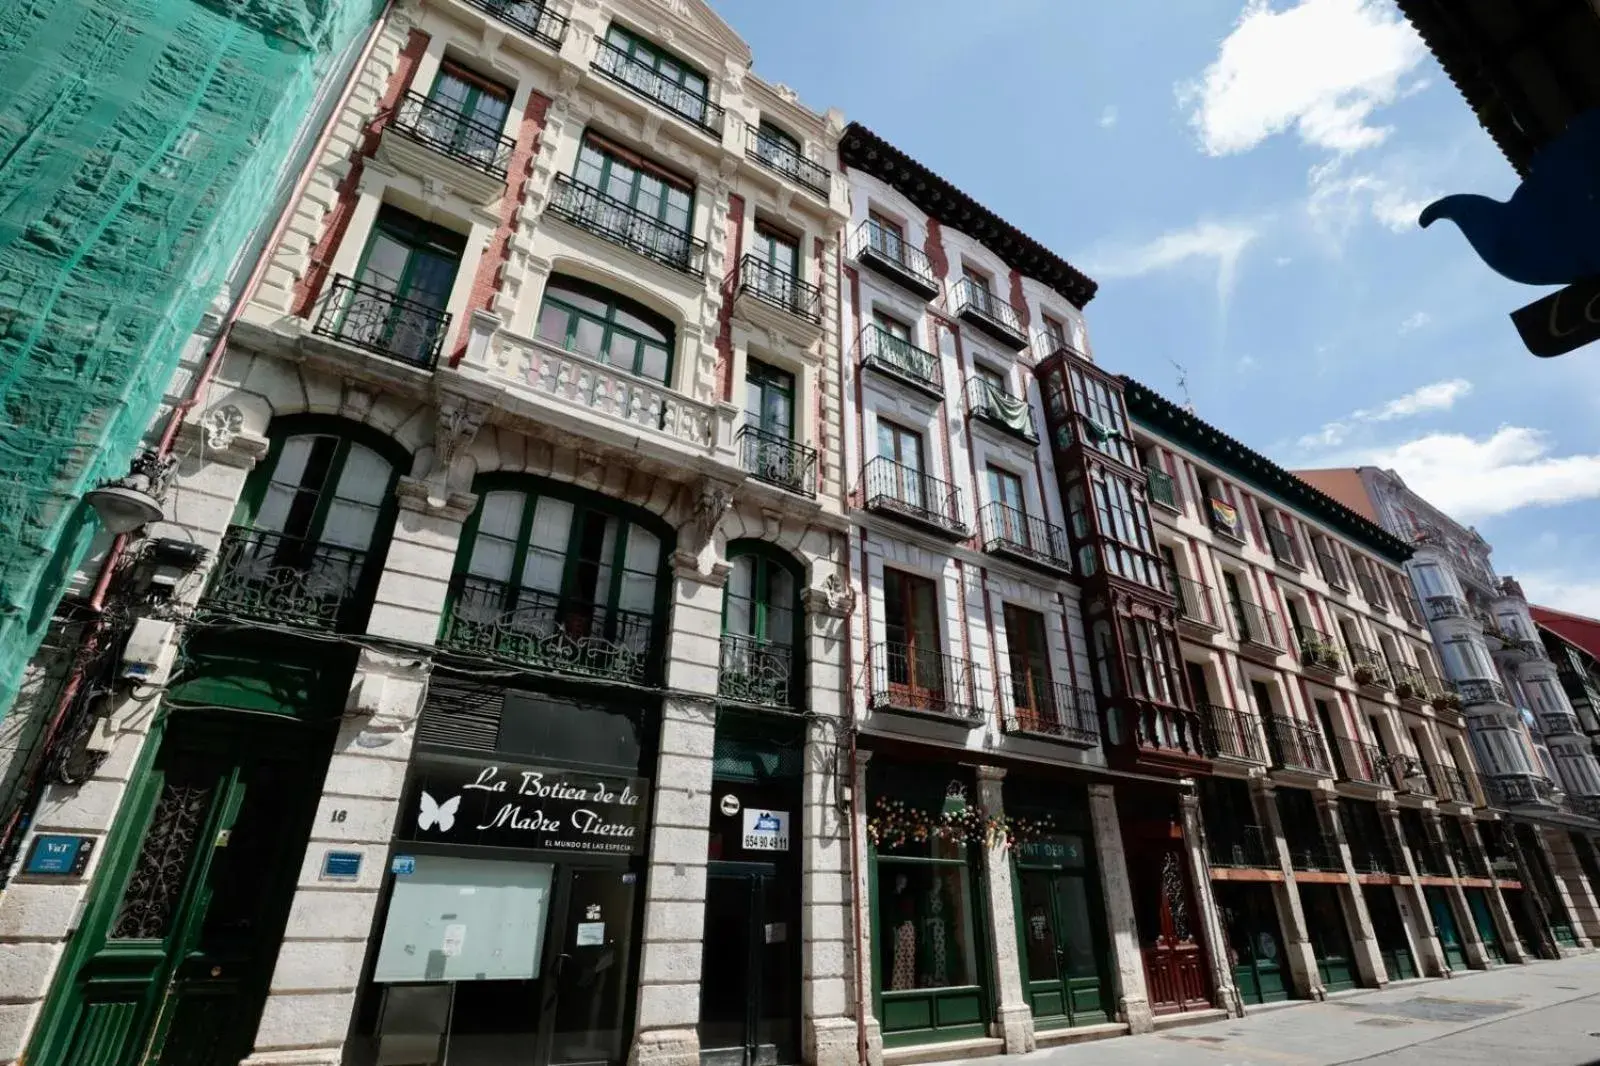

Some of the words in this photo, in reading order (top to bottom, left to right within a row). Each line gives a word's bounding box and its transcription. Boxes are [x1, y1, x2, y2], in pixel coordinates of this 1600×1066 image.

[463, 766, 507, 792] La
[518, 771, 587, 800] Botica
[593, 782, 614, 803] de
[619, 785, 639, 806] la
[476, 803, 560, 832] Madre
[571, 809, 637, 837] Tierra
[545, 839, 553, 847] EL
[554, 840, 581, 849] MUNDO
[582, 842, 591, 850] DE
